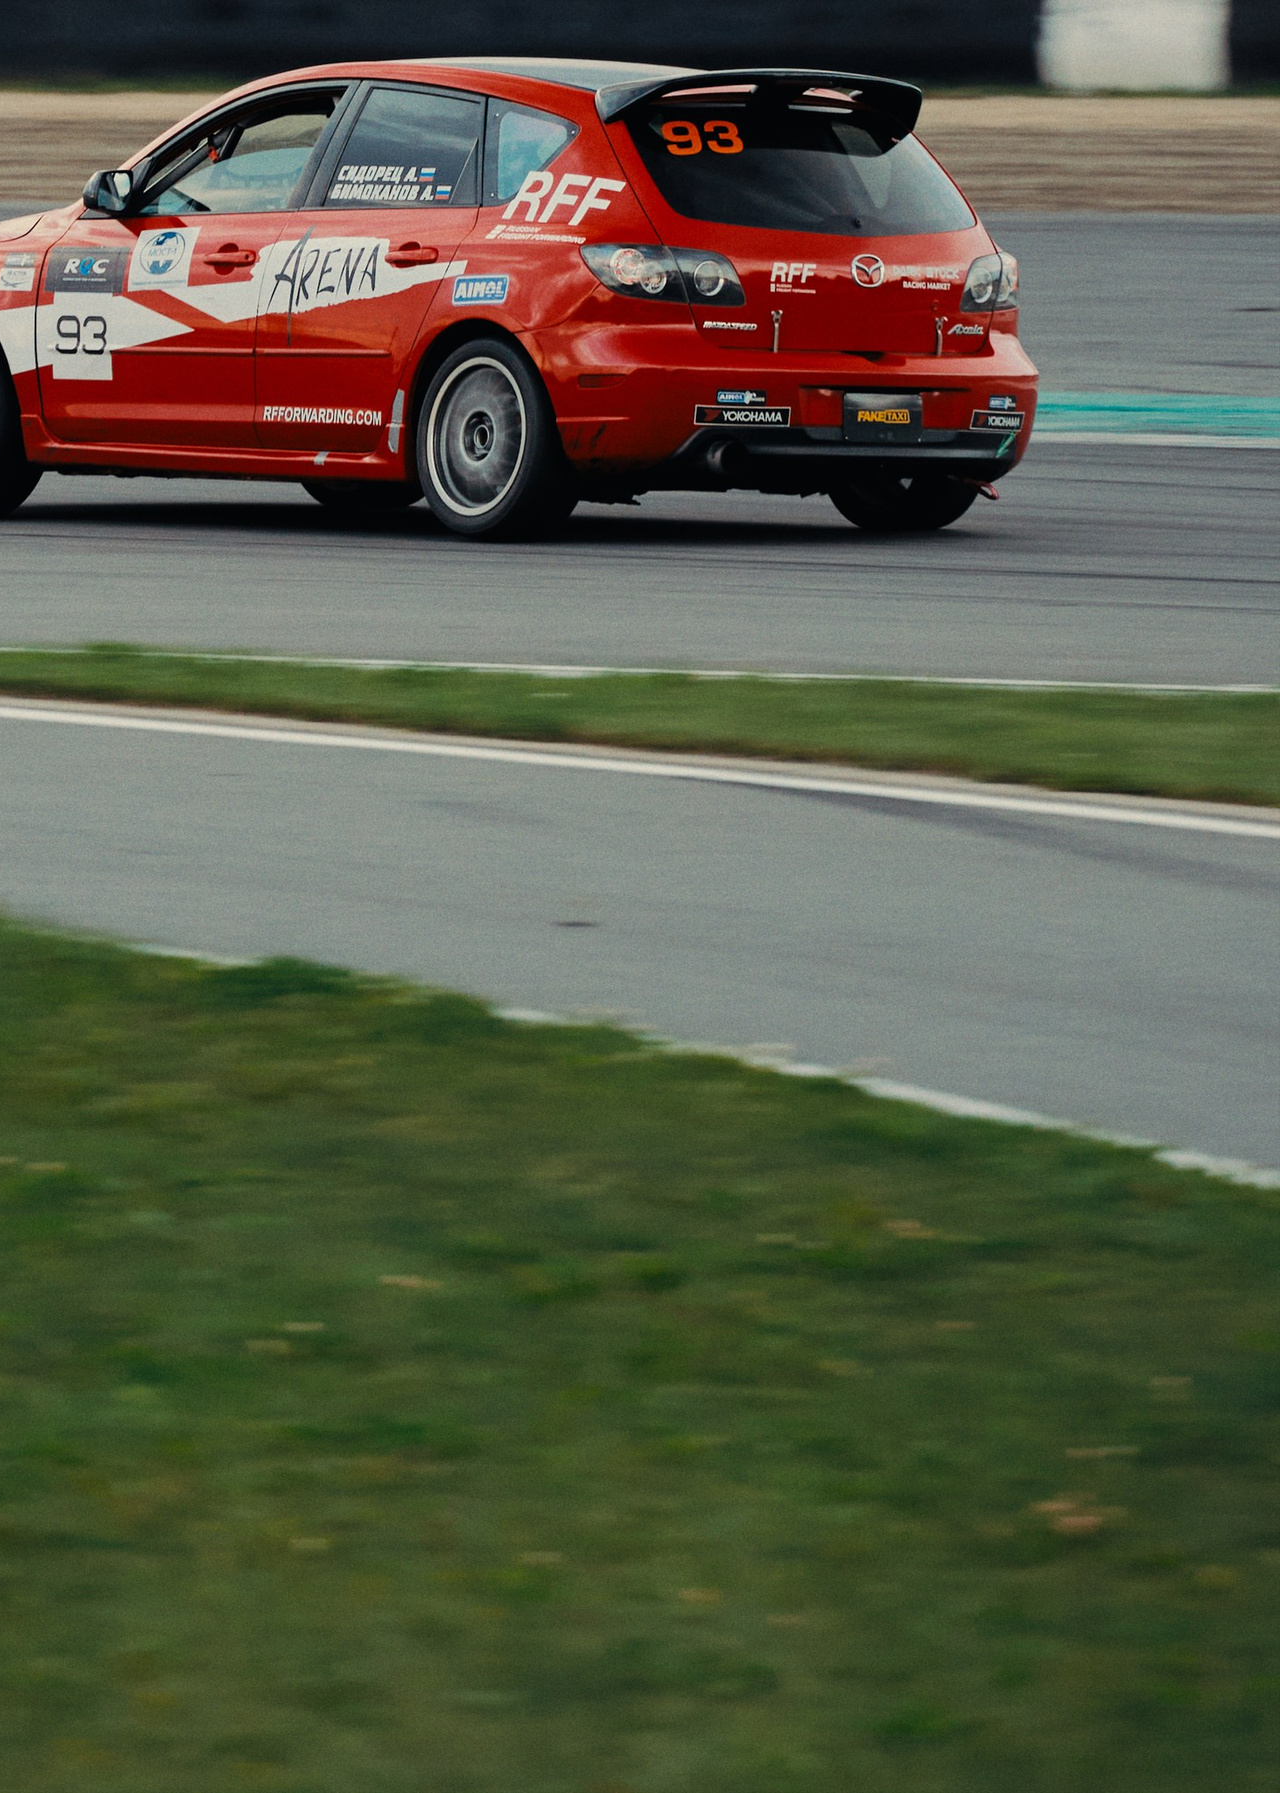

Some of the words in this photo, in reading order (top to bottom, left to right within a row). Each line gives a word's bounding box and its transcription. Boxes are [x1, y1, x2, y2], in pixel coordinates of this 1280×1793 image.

[661, 119, 744, 156] 93
[337, 165, 404, 184] СИДОРЕЦ
[501, 170, 626, 226] RFF
[770, 261, 817, 283] RFF
[266, 223, 380, 346] ARENA
[455, 280, 504, 299] AIMOL
[55, 315, 107, 355] 93
[263, 405, 382, 426] RFFORWARDING.COM
[722, 410, 783, 423] YOKOHAMA
